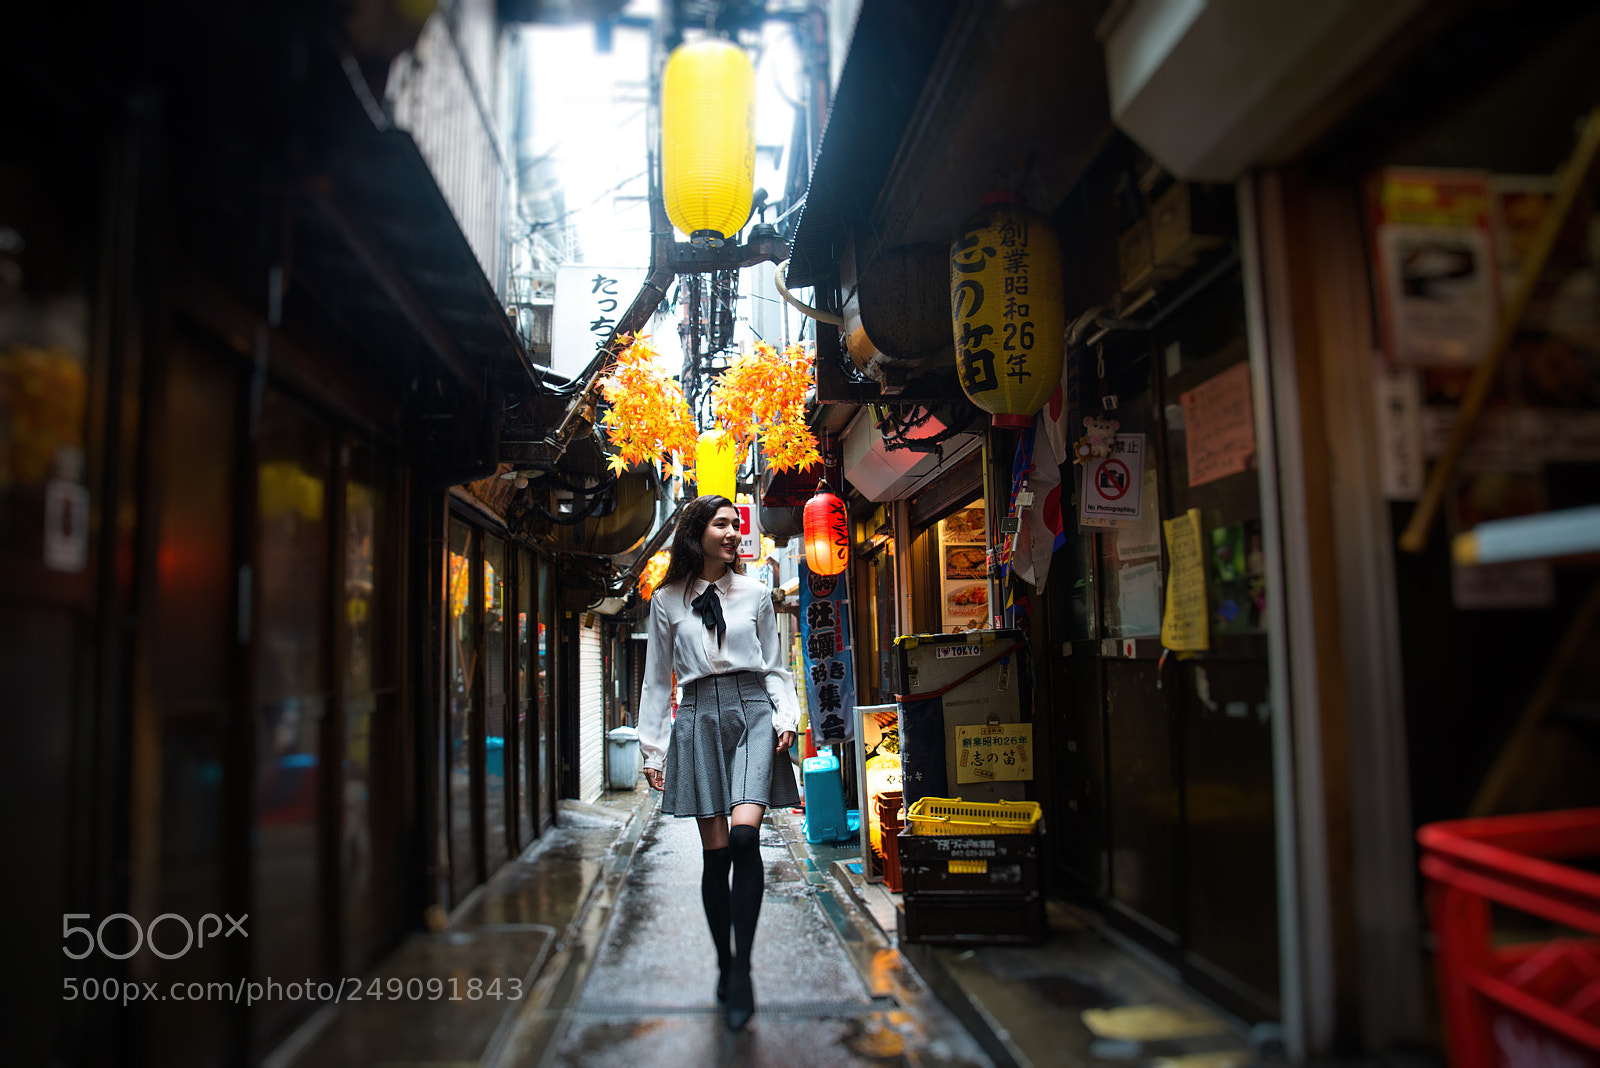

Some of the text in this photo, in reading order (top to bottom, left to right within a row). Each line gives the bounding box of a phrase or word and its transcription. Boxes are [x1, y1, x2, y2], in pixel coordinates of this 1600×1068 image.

[998, 219, 1035, 385] 創業昭和26年
[1114, 440, 1138, 454] 禁止
[1097, 505, 1136, 514] Photographing
[740, 539, 753, 547] LET
[951, 645, 980, 656] TOKYO
[962, 735, 1029, 748] 創業昭和26年
[970, 750, 1016, 767] 志の笛
